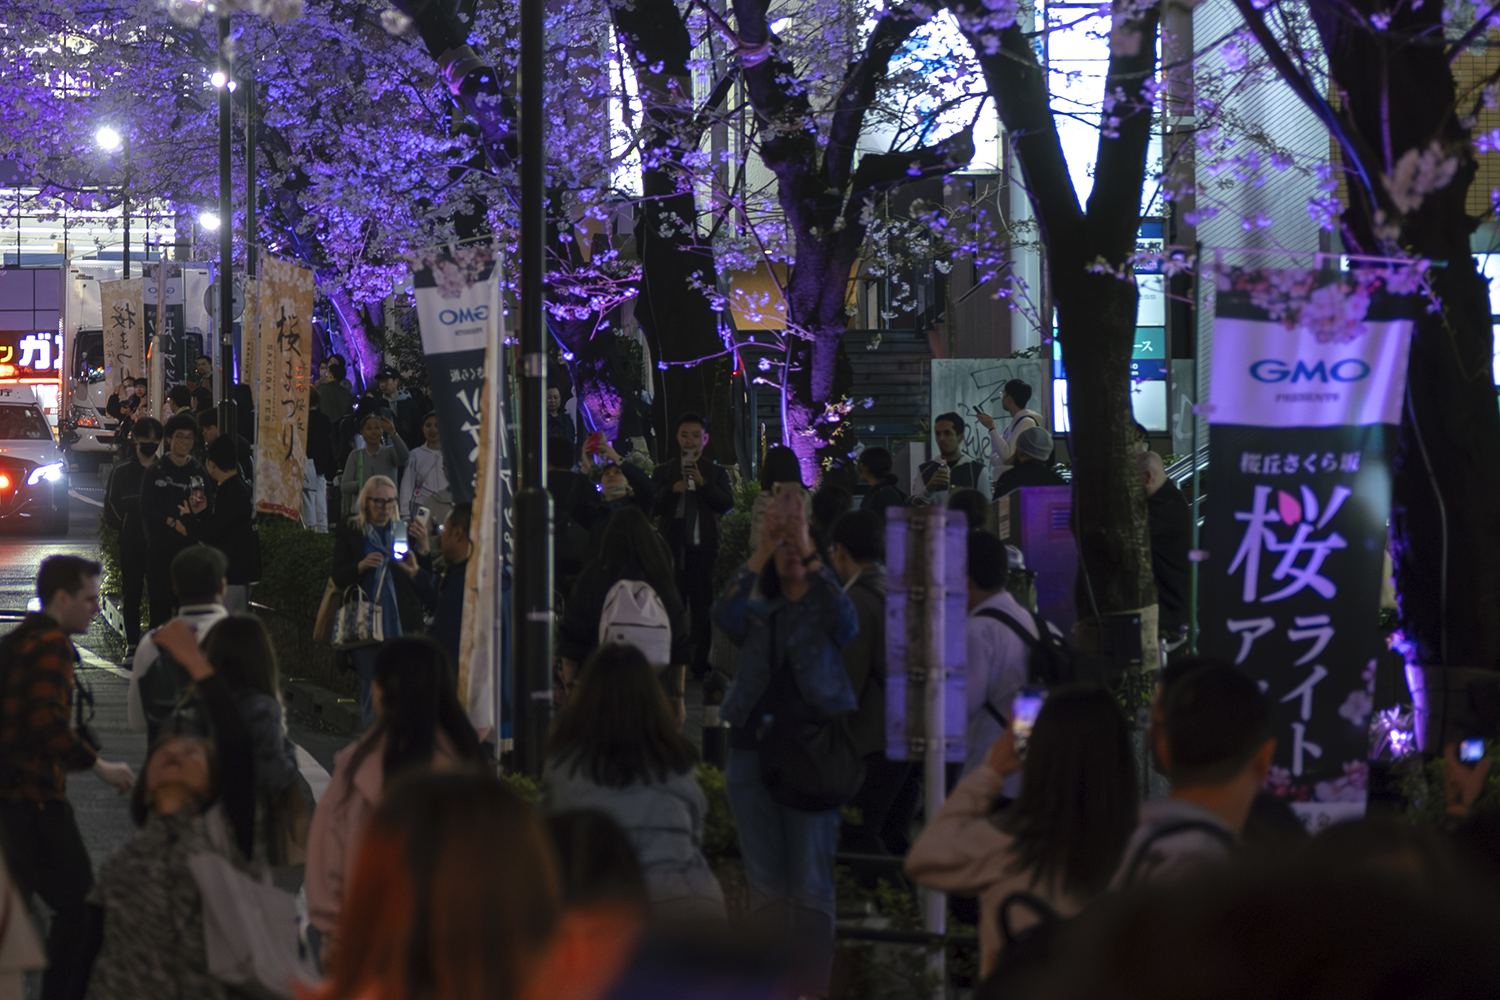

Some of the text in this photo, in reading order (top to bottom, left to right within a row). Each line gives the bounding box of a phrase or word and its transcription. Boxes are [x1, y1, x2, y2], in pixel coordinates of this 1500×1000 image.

[265, 343, 274, 392] SAKURA
[275, 305, 302, 461] 桜まつり
[1249, 357, 1371, 383] GMO
[1239, 451, 1361, 476] 桜丘さくら坂
[1227, 484, 1353, 605] 桜
[1279, 613, 1335, 778] ライト
